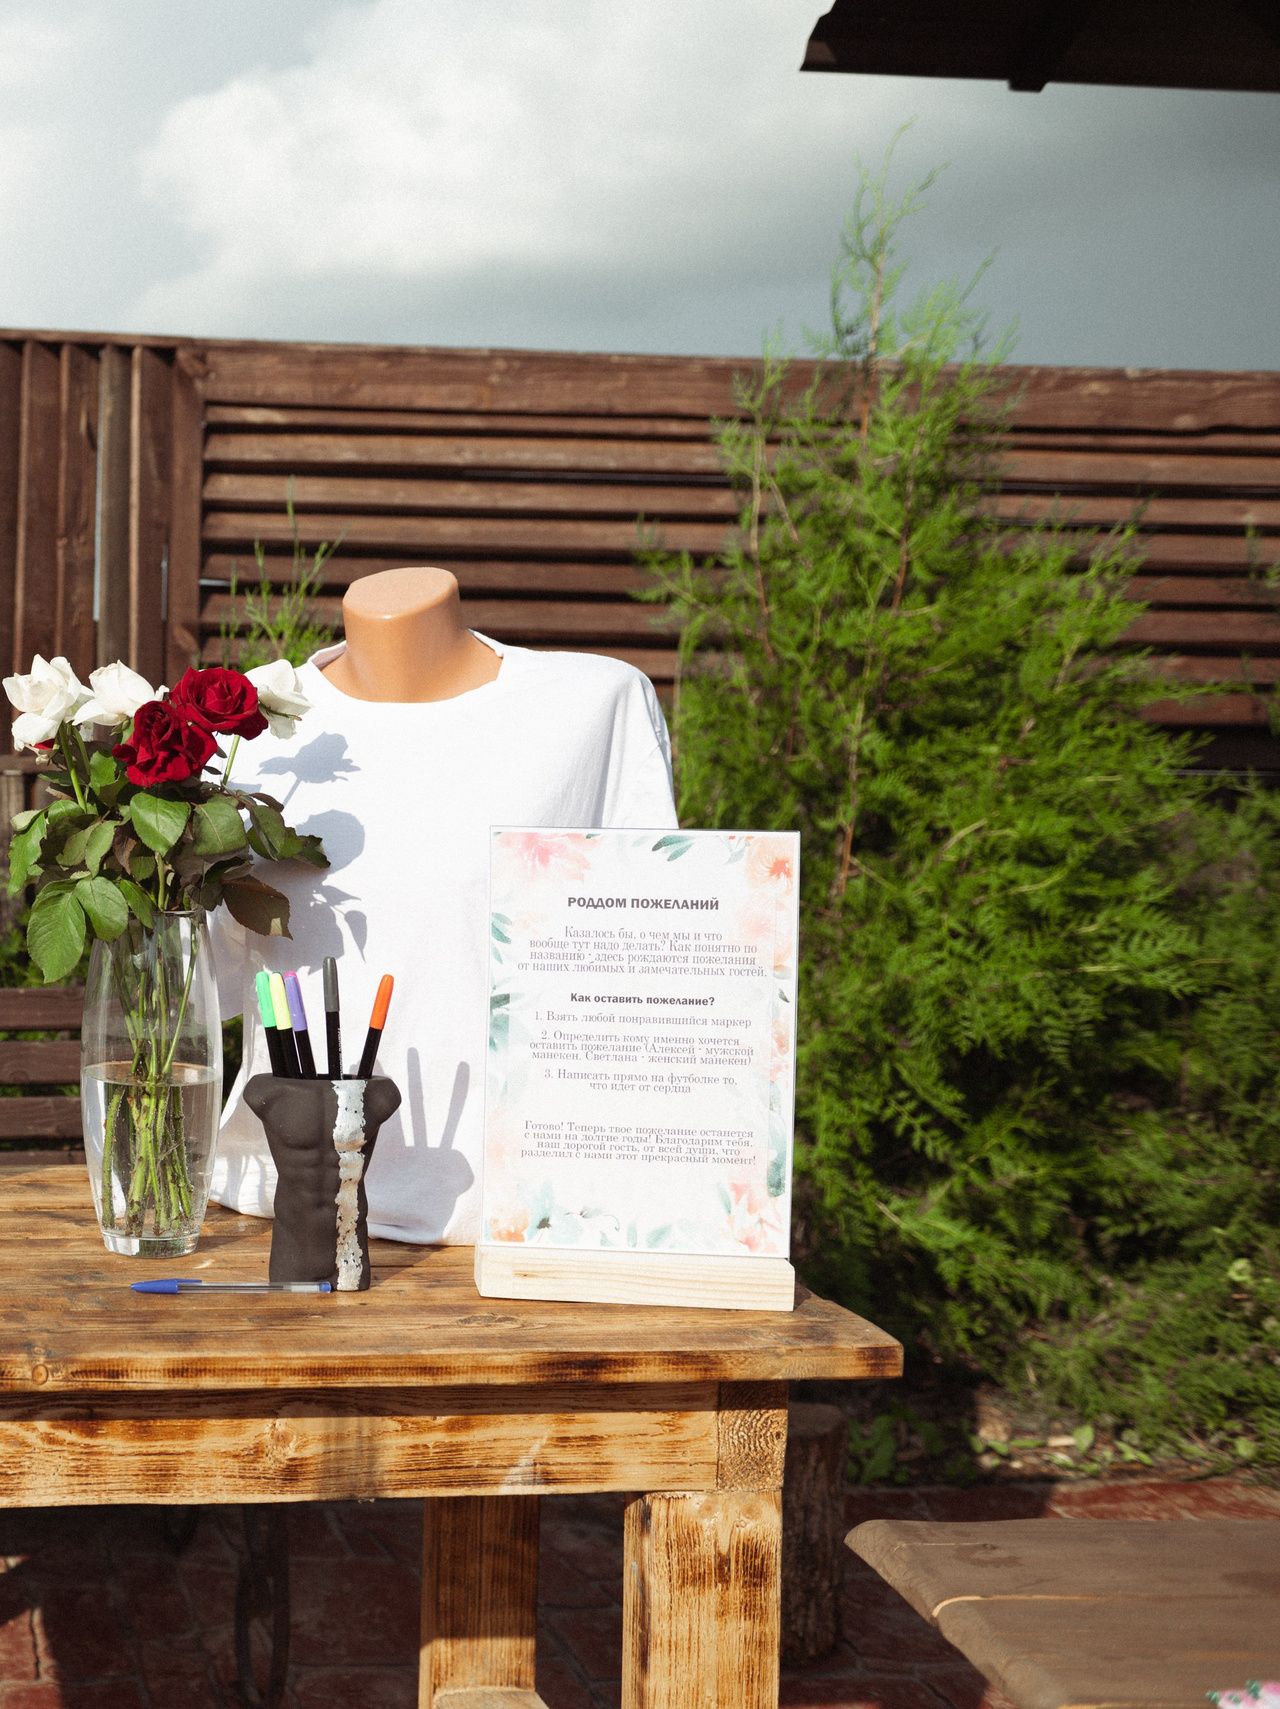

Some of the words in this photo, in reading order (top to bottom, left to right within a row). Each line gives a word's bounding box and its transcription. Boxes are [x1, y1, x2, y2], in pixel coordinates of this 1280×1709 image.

[567, 897, 627, 909] РОДДОМ
[631, 897, 719, 910] ПОЖЕЛАНИЙ
[564, 926, 616, 939] Казалось
[618, 927, 636, 940] бы,
[639, 931, 646, 939] о
[649, 931, 670, 940] чем
[673, 932, 690, 940] мы
[693, 932, 700, 940] и
[704, 932, 723, 941] что
[529, 937, 570, 950] вообще
[572, 941, 590, 952] тут
[593, 941, 620, 950] надо
[622, 940, 666, 952] делать?
[669, 940, 691, 952] Как
[694, 944, 741, 953] понятно
[744, 945, 757, 953] по
[530, 951, 585, 960] названию
[595, 953, 625, 963] здесь
[627, 954, 689, 964] рождаются
[692, 956, 756, 965] пожелания
[517, 962, 529, 971] от
[532, 962, 570, 972] наших
[572, 961, 625, 973] любимых
[628, 965, 635, 973] и
[638, 965, 725, 976] замечательных
[729, 966, 767, 977] гостей.
[570, 992, 591, 1002] Как
[594, 995, 643, 1004] оставить
[646, 997, 715, 1006] пожелание?
[535, 1011, 543, 1020] 1.
[546, 1011, 578, 1021] Взять
[581, 1012, 615, 1023] любой
[618, 1015, 708, 1026] понравившийся
[711, 1018, 752, 1029] маркер
[541, 1030, 550, 1040] 2.
[553, 1030, 620, 1042] Определить
[623, 1035, 650, 1045] кому
[653, 1036, 695, 1045] именно
[698, 1037, 740, 1046] хочется
[529, 1041, 577, 1051] оставить
[580, 1043, 642, 1052] пожелание
[645, 1043, 695, 1054] (Алексей
[705, 1047, 754, 1058] мужской
[585, 1051, 637, 1062] Светлана
[648, 1055, 697, 1064] женский
[700, 1056, 751, 1066] манекен)
[544, 1069, 554, 1079] 3.
[558, 1069, 610, 1080] Написать
[613, 1073, 648, 1082] прямо
[651, 1074, 664, 1082] на
[667, 1072, 720, 1085] футболке
[589, 1082, 608, 1090] что
[610, 1083, 636, 1092] идет
[638, 1083, 651, 1092] от
[653, 1084, 691, 1094] сердца
[525, 1120, 564, 1131] Готово!
[567, 1121, 606, 1134] Теперь
[635, 1127, 697, 1136] пожелание
[699, 1129, 754, 1138] останется
[524, 1131, 530, 1139] с
[533, 1132, 561, 1140] нами
[580, 1134, 619, 1142] долгие
[622, 1134, 651, 1144] годы!
[655, 1134, 722, 1147] Благодарим
[537, 1141, 560, 1149] наш
[562, 1142, 606, 1151] дорогой
[643, 1145, 655, 1153] от
[658, 1145, 682, 1154] всей
[722, 1148, 740, 1156] что
[521, 1149, 572, 1158] разделил
[641, 1154, 708, 1164] прекрасный
[712, 1155, 756, 1165] момент!
